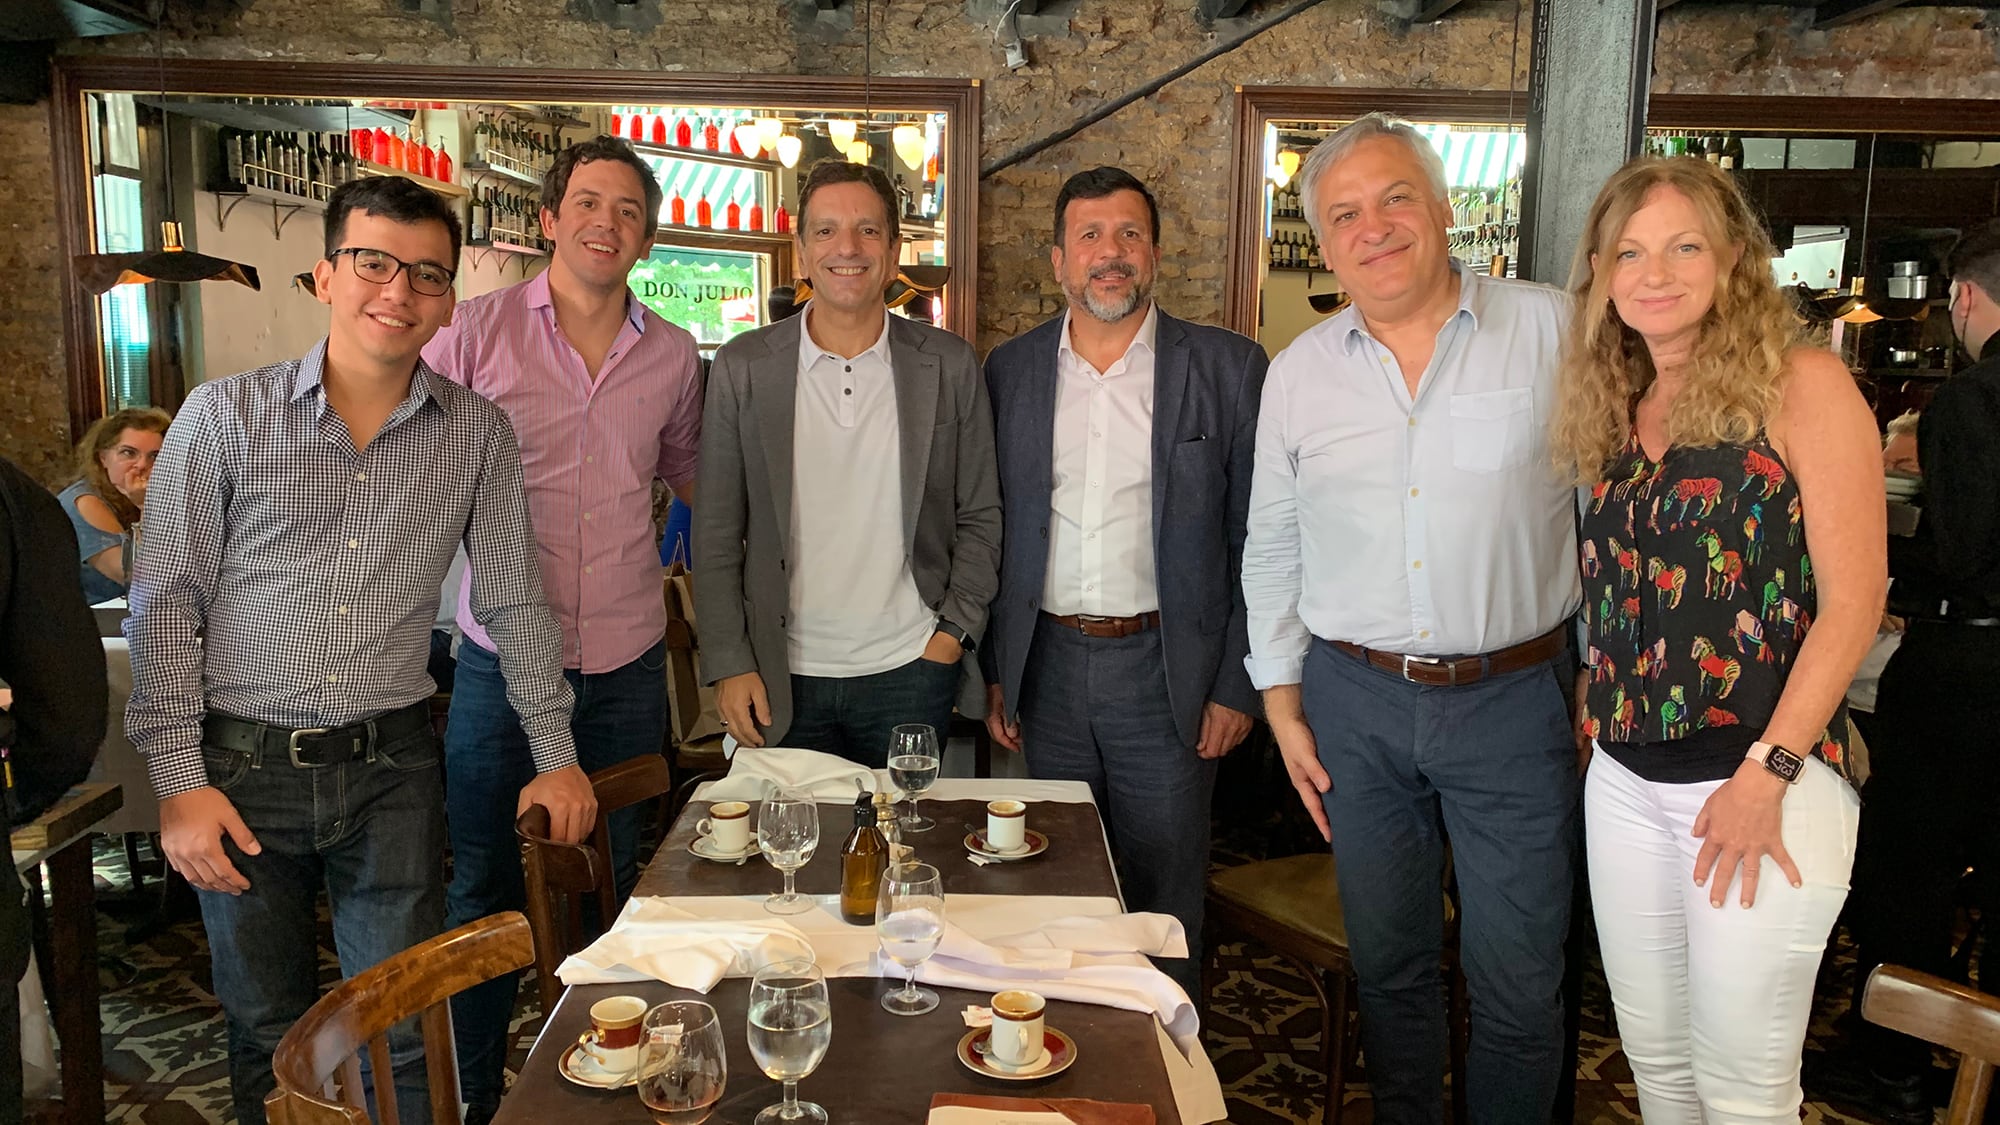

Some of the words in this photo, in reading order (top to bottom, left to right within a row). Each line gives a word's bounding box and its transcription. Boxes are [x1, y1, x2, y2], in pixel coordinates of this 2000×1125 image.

[644, 281, 688, 298] DON
[694, 284, 753, 303] JULIO
[1771, 753, 1786, 770] 37
[1781, 762, 1796, 776] 13
